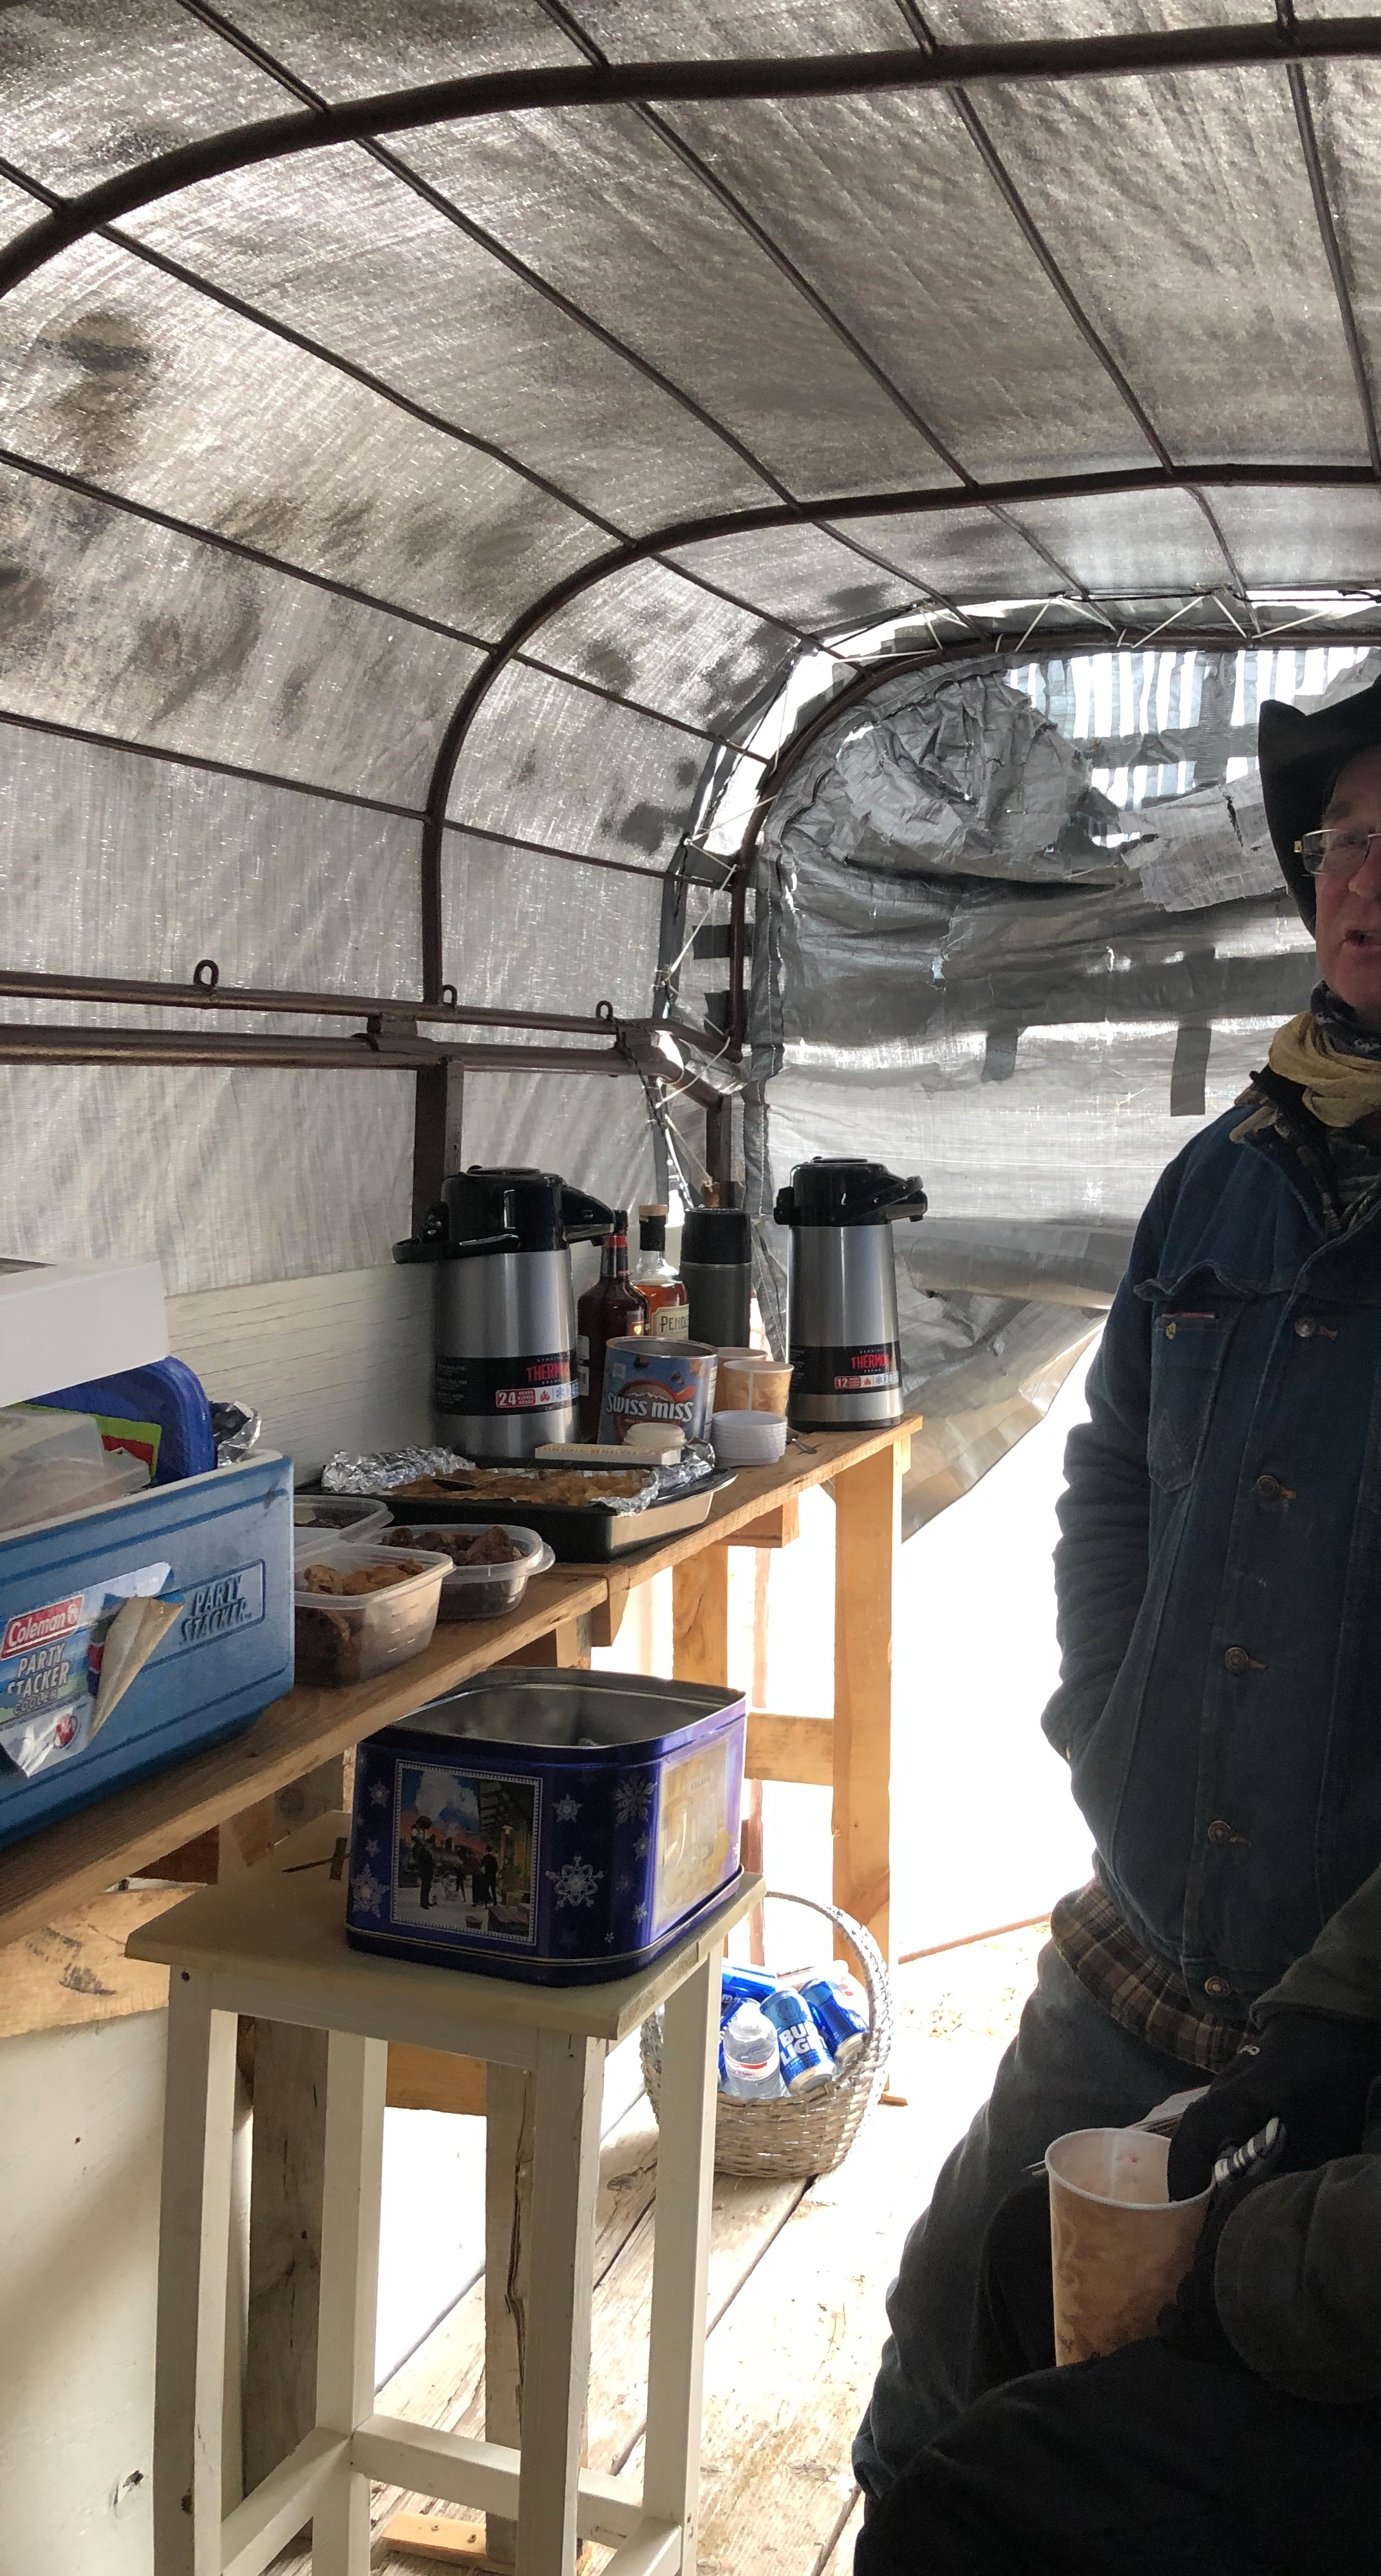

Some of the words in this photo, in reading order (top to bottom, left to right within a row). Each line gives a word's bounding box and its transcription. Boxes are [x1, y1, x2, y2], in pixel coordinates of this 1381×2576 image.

[499, 1392, 516, 1406] 24
[837, 1378, 848, 1387] 12
[606, 1392, 648, 1416] SWISS
[652, 1401, 694, 1423] MISS
[191, 1574, 242, 1616] PARTY
[8, 1612, 66, 1647] Coleman
[17, 1642, 66, 1679] PARTY
